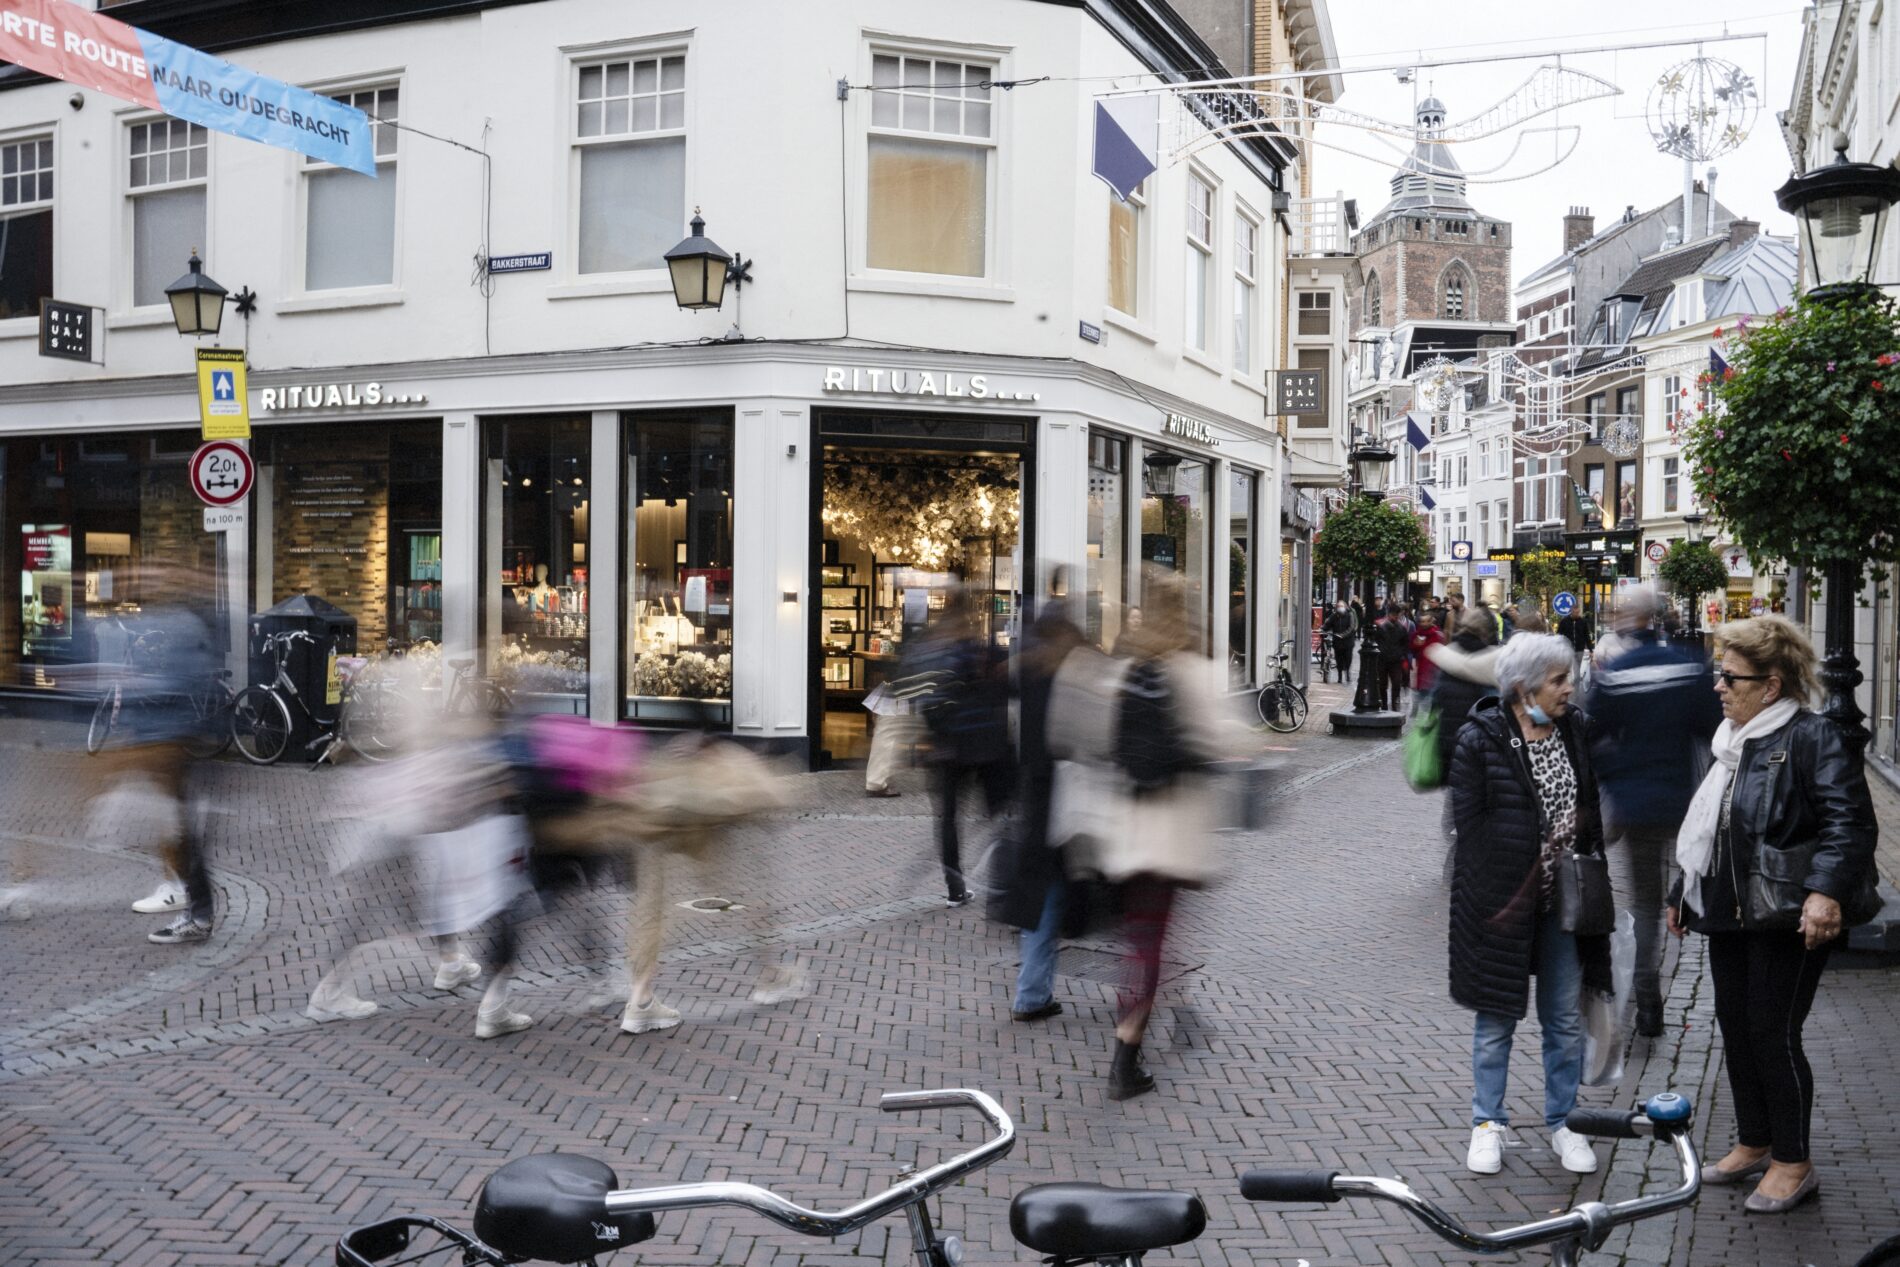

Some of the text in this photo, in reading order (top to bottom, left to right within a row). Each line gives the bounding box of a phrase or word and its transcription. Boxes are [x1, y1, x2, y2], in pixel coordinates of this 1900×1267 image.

[0, 10, 350, 146] RTE ROUTE NAAR OUDEGRACHT
[491, 256, 546, 270] BAKKERSTRAAT
[206, 515, 243, 525] na 100 m
[1490, 552, 1515, 560] sacha
